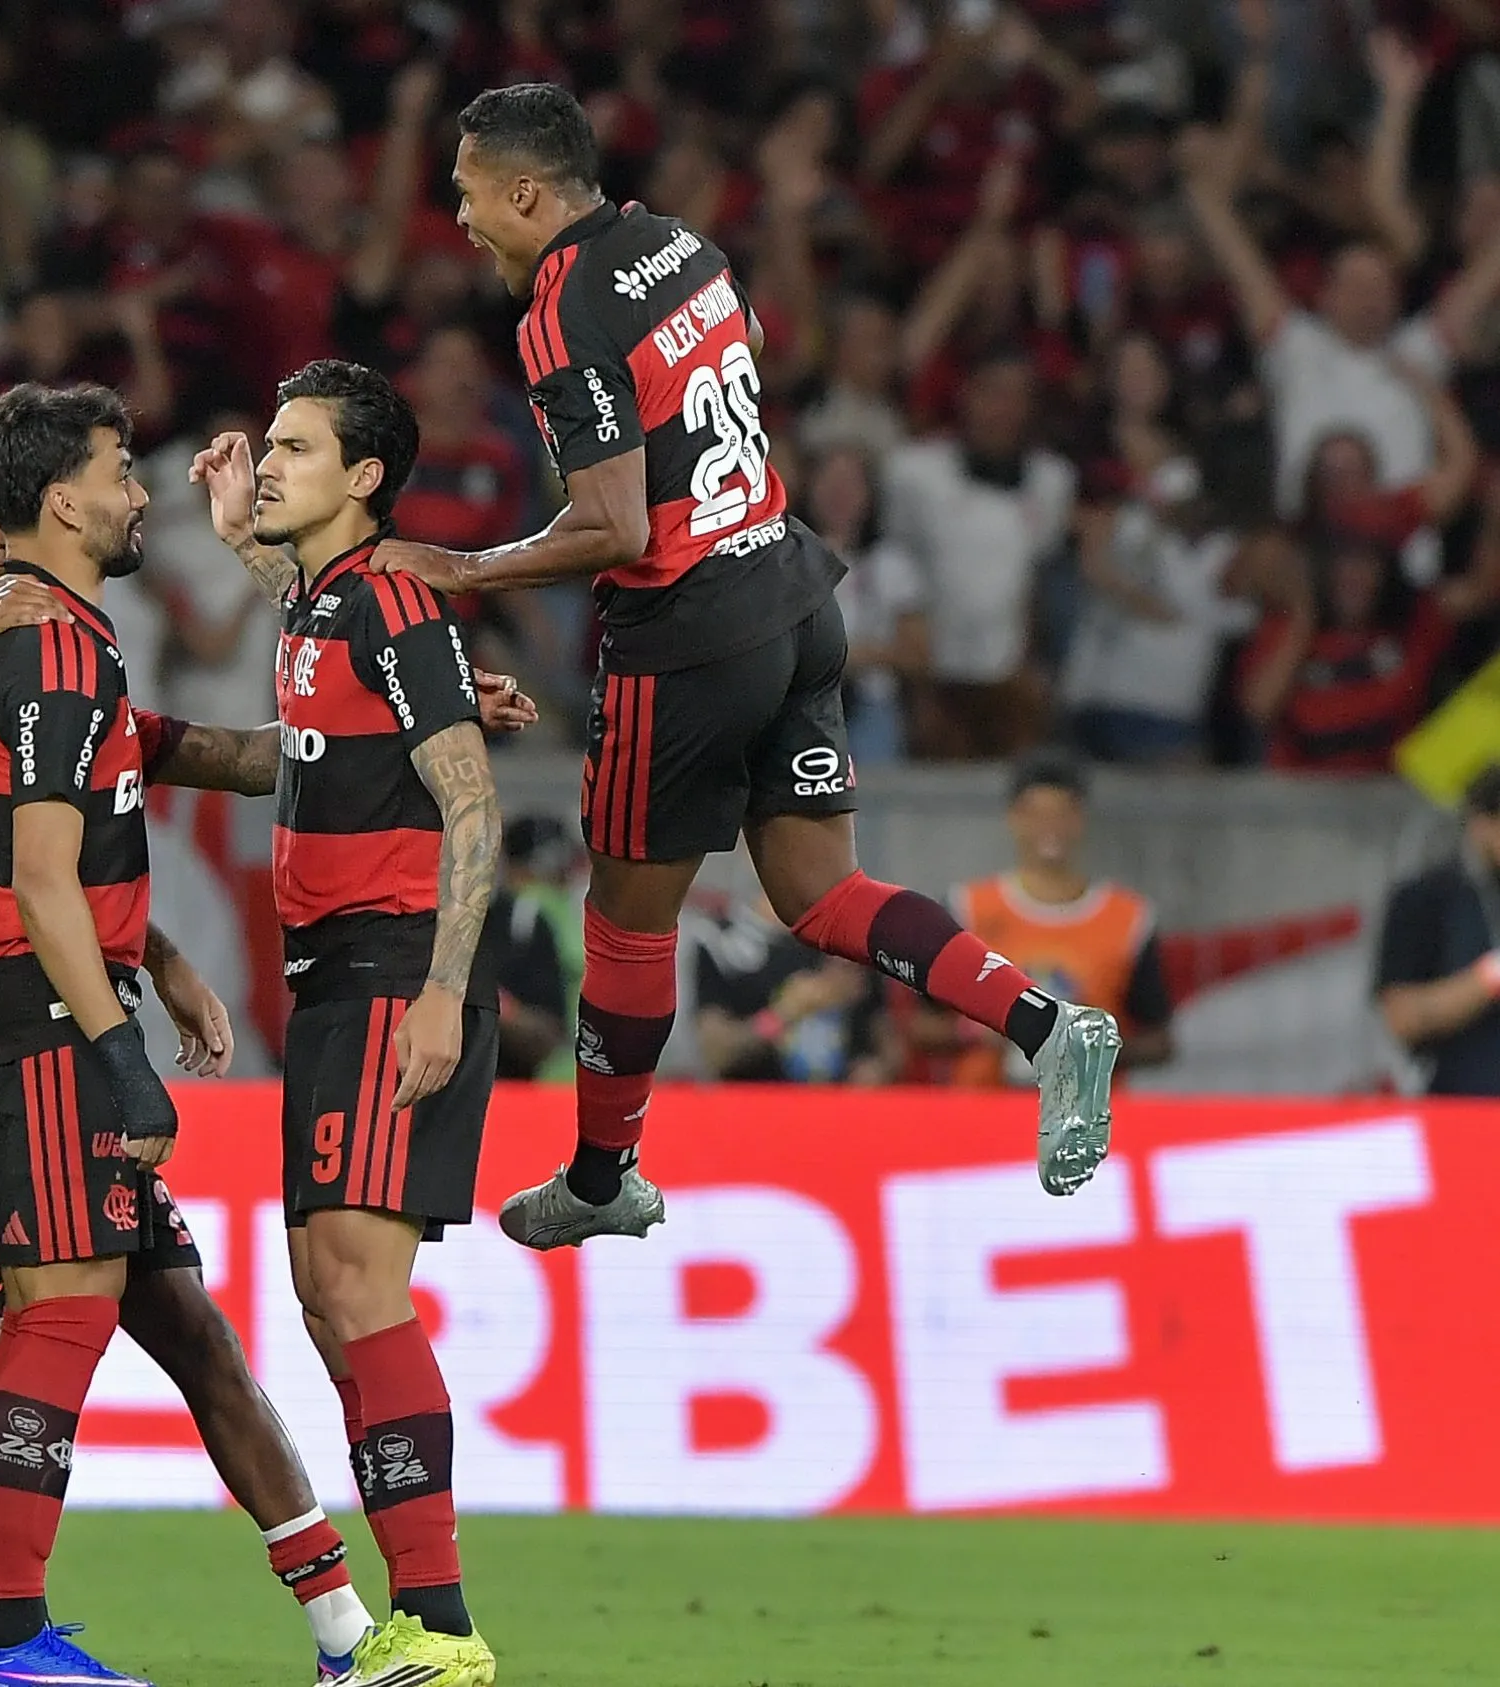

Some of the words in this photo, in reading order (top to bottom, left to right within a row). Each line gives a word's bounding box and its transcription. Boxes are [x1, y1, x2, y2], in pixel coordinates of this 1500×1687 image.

[653, 309, 704, 369] ALEX
[689, 274, 739, 334] SANDR
[583, 367, 620, 443] Shopee
[376, 646, 416, 731] Shopee
[17, 701, 40, 786] Shopee
[793, 776, 845, 796] GAC
[91, 1131, 129, 1162] Wa
[311, 1111, 345, 1184] 9
[381, 1458, 429, 1483] Zé
[386, 1474, 430, 1491] DELIVERY
